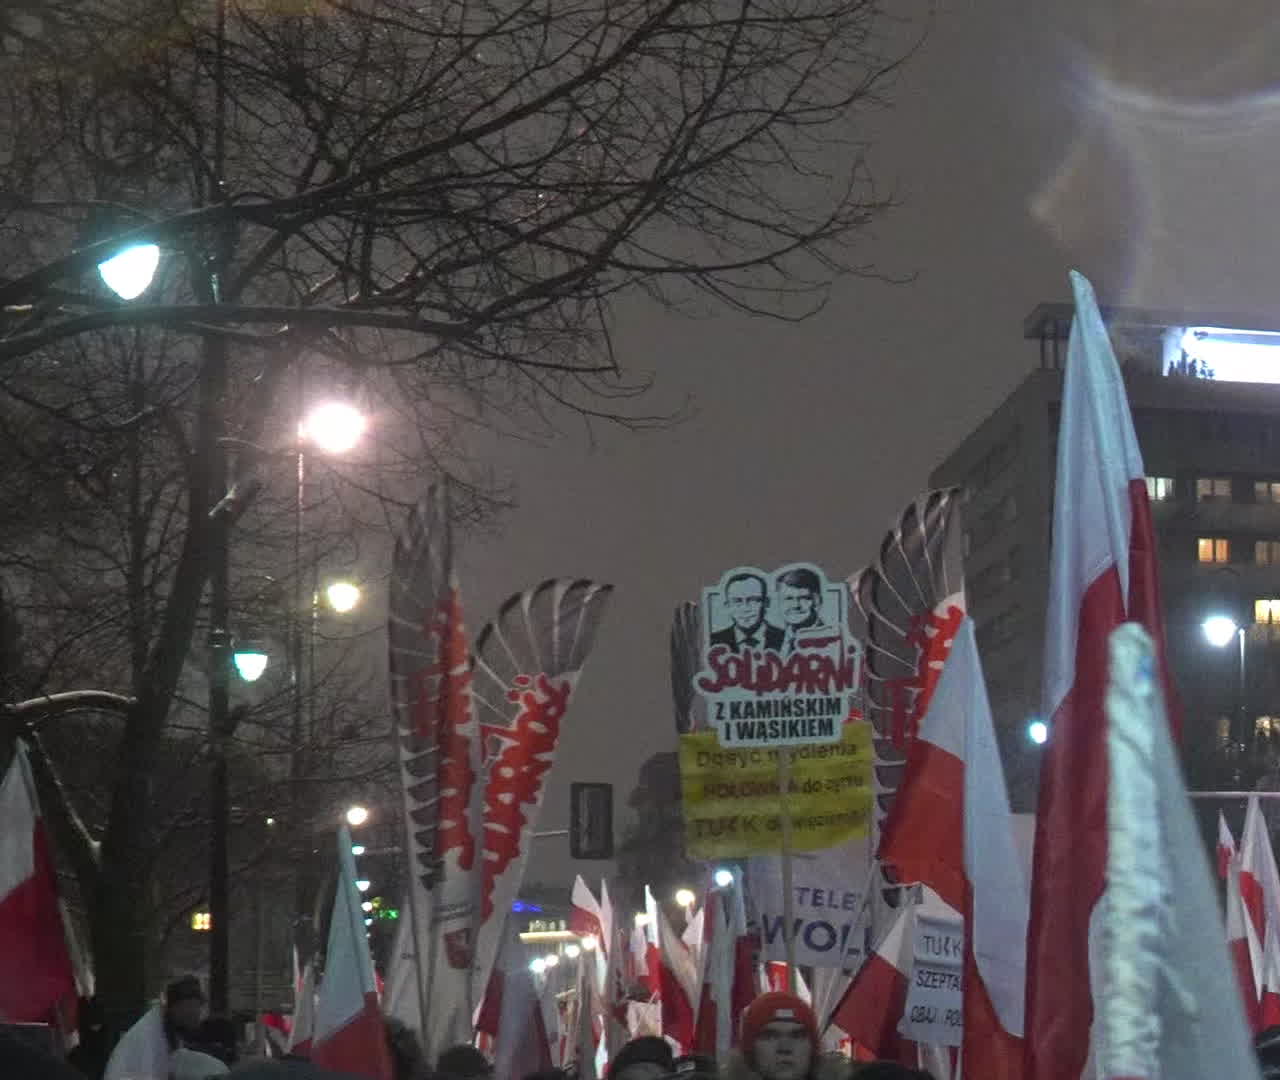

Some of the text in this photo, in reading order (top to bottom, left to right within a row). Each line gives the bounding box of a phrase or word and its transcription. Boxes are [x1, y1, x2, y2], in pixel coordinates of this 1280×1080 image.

[716, 697, 841, 720] Z KAMIŃSKIM
[725, 718, 834, 742] I WĄSIKIEM
